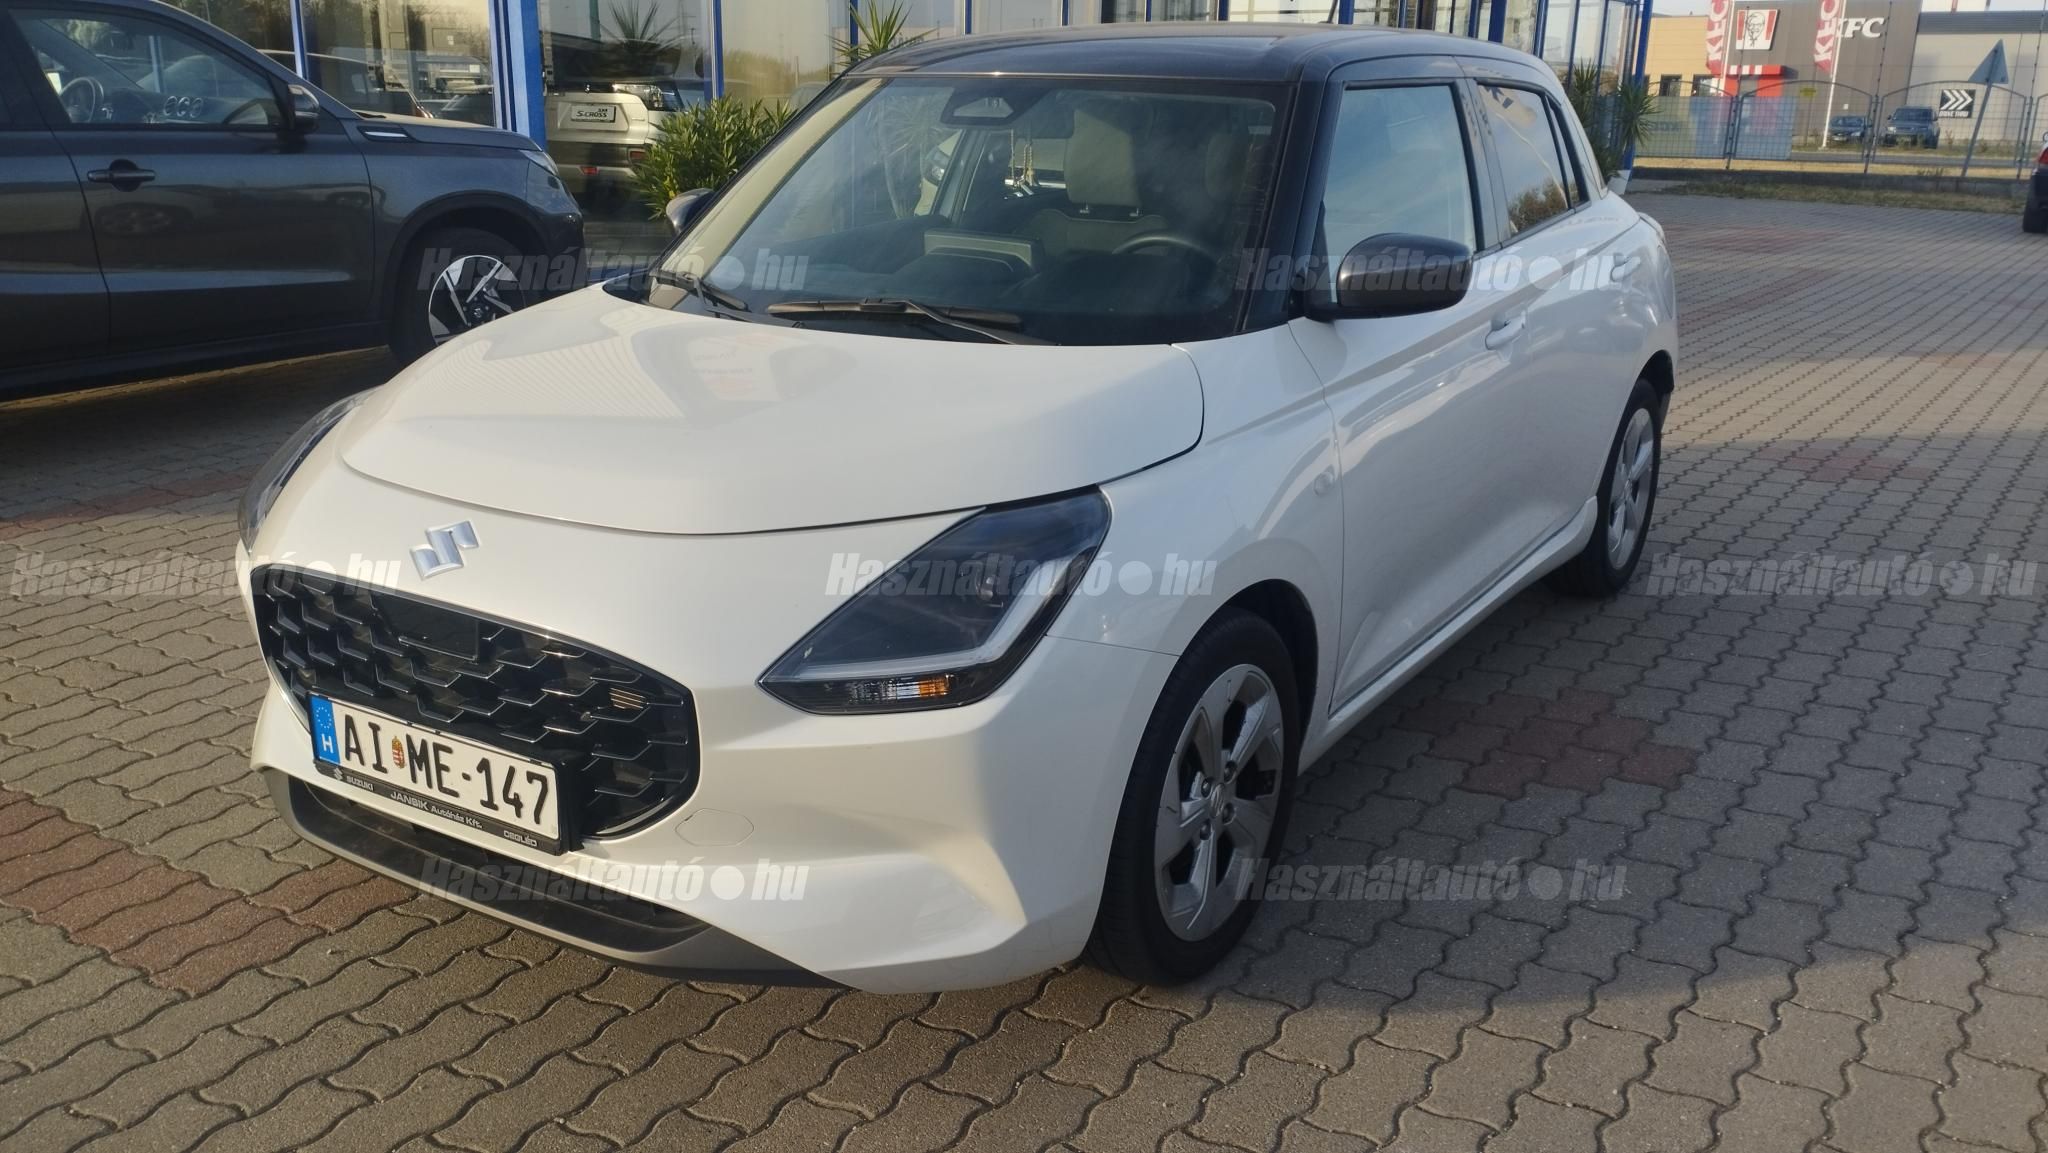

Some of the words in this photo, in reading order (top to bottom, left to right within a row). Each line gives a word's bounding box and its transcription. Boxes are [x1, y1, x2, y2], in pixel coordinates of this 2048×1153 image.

[1706, 0, 1728, 61] KFC
[1814, 0, 1839, 62] KFC
[321, 734, 333, 753] H
[344, 714, 388, 774] AI
[405, 733, 549, 825] ME-147
[346, 775, 374, 792] SUZUKI
